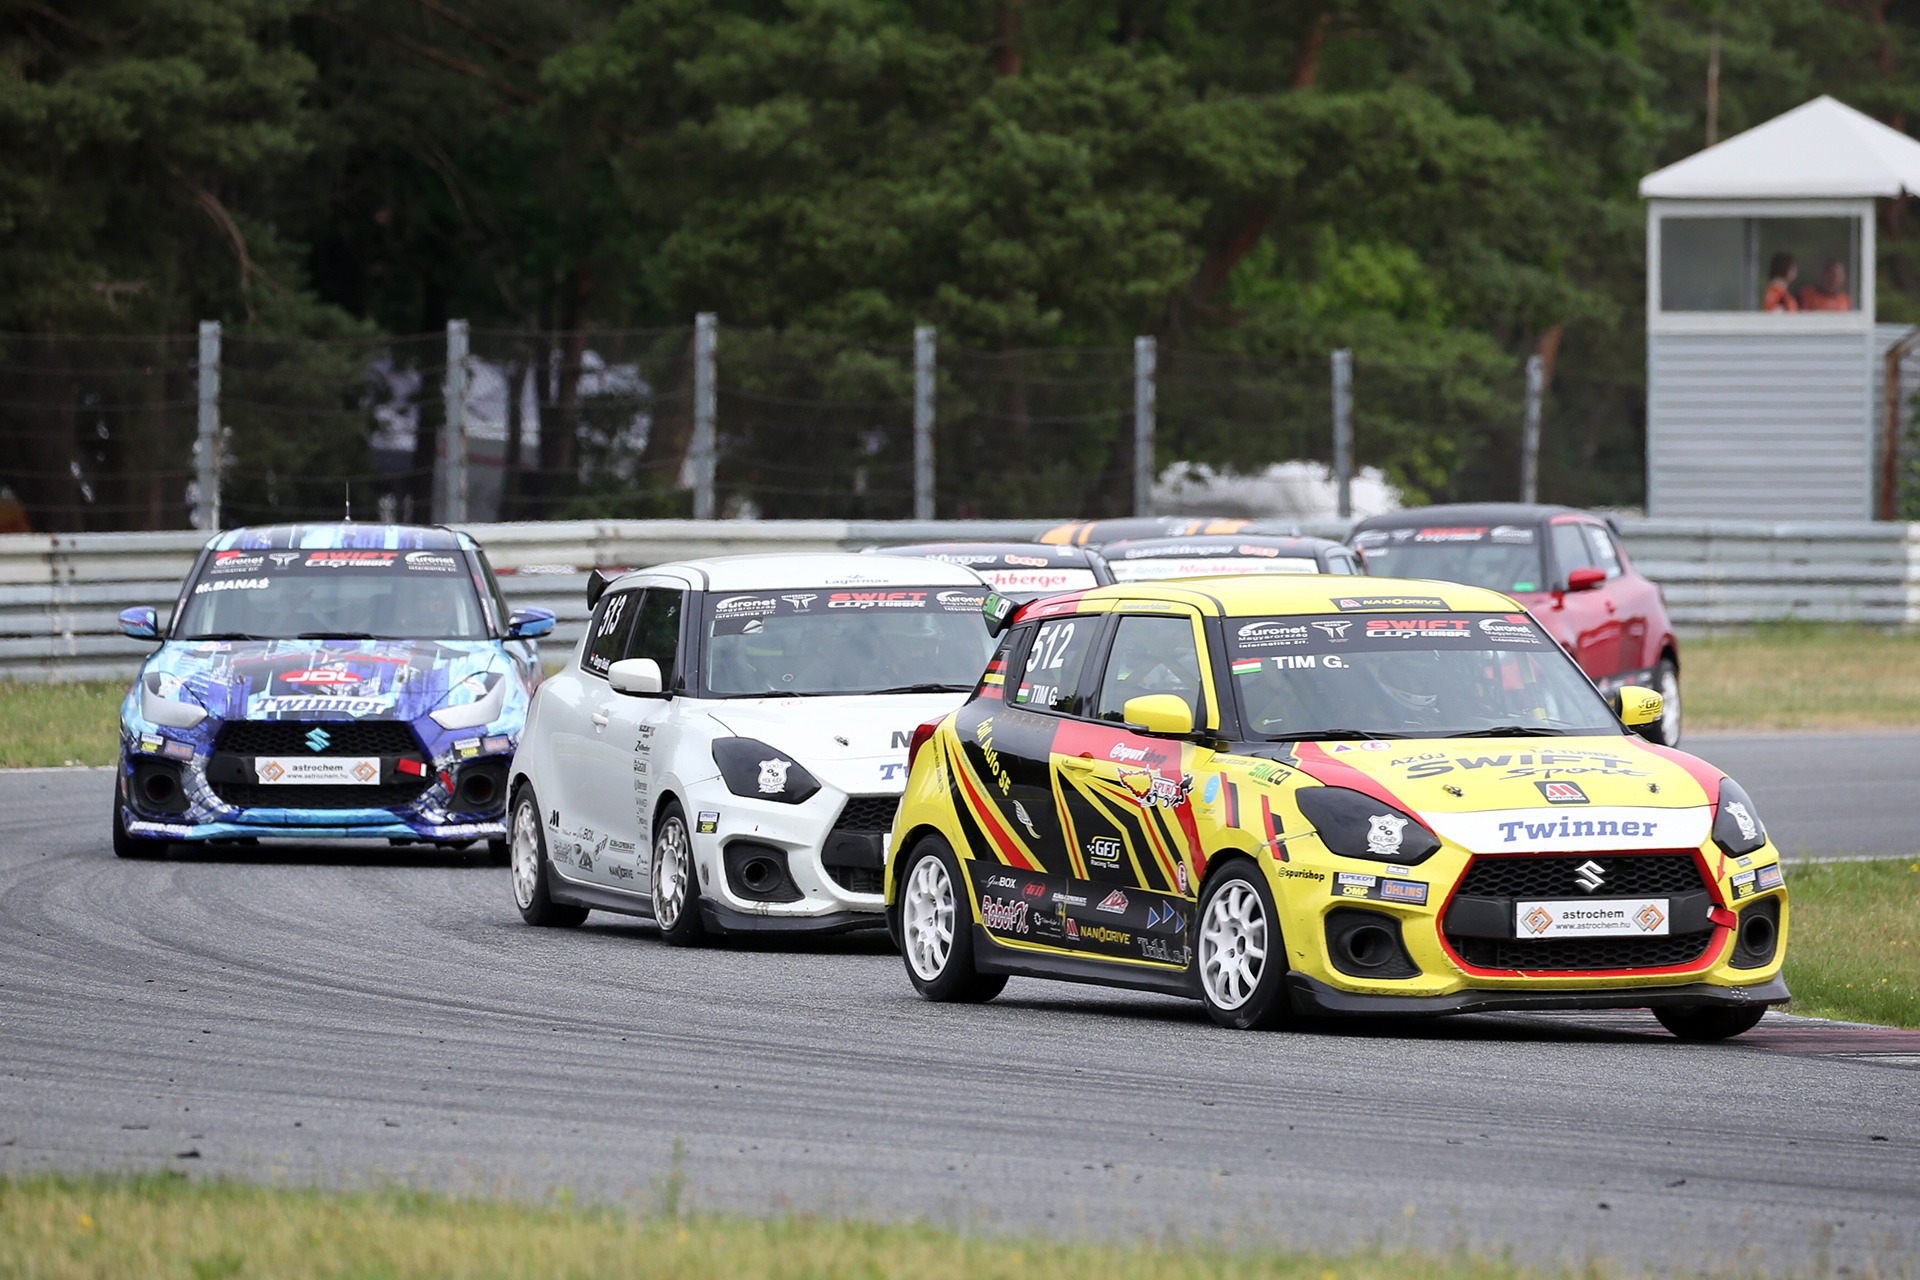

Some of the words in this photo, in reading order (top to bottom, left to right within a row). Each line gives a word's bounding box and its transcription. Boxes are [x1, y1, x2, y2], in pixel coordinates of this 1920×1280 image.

[308, 552, 399, 560] SWIFT
[829, 592, 929, 601] SWIFT
[597, 594, 627, 638] 513
[1237, 624, 1308, 637] euronet
[1366, 619, 1471, 630] SWIFT
[1479, 622, 1532, 634] euronet
[1366, 630, 1418, 639] CUP
[1420, 630, 1472, 638] EUROPE
[1026, 622, 1075, 673] 512
[1271, 655, 1316, 670] TIM
[1322, 655, 1350, 669] G.
[285, 670, 360, 683] JDL
[1030, 684, 1047, 705] TIM
[1048, 686, 1059, 706] G.
[255, 697, 387, 713] Twinner
[1109, 742, 1168, 768] @spurishop
[1557, 749, 1619, 758] TURBO
[292, 764, 343, 773] astrochem
[981, 736, 1000, 776] Auto
[998, 769, 1012, 797] SE
[1406, 754, 1634, 779] SWIFT
[1498, 767, 1653, 780] Sport
[286, 772, 348, 780] www.astrochem.hu
[1248, 763, 1292, 786] SIMCO
[1153, 781, 1175, 796] SPURI
[1498, 816, 1658, 842] Twinner
[1095, 841, 1120, 857] GFS
[1090, 859, 1106, 869] Racing
[1107, 860, 1120, 870] Team
[1278, 867, 1325, 882] @spurishop
[1340, 873, 1375, 882] SPEEDY
[1342, 886, 1369, 897] OMP
[1384, 881, 1424, 898] ÖHLINS
[982, 895, 1029, 934] Robot-X
[1562, 908, 1624, 920] astrochem
[1555, 921, 1631, 931] www.astrochem.hu
[1080, 925, 1131, 945] NANODRIVE
